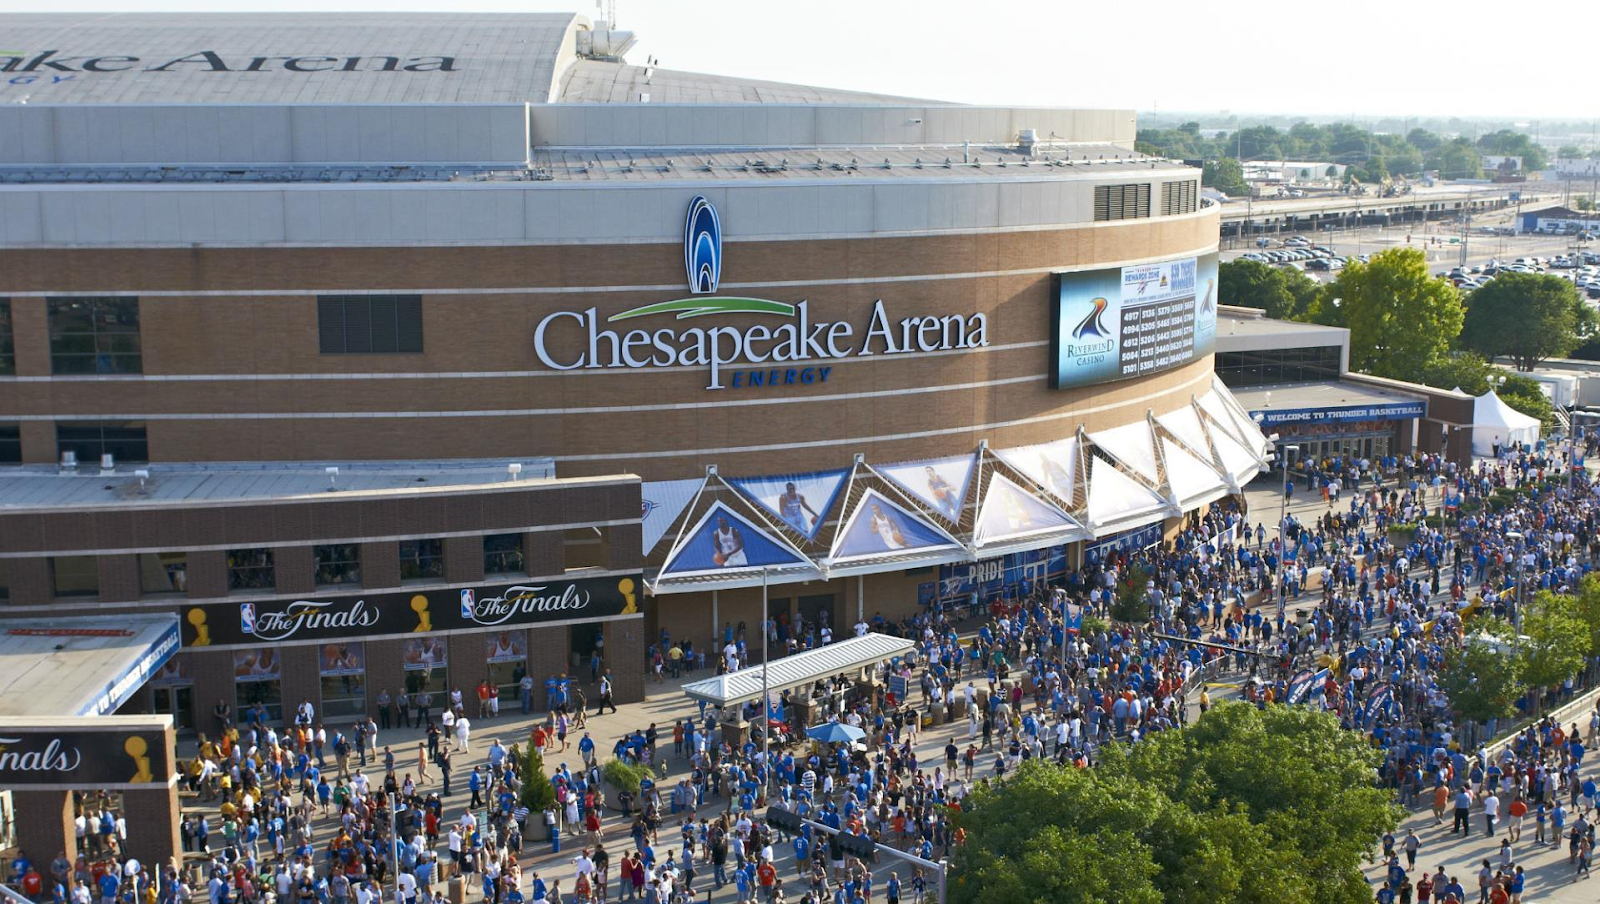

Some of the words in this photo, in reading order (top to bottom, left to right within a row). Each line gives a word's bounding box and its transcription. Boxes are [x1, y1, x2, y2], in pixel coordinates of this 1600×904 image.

[145, 50, 462, 73] Arena
[533, 300, 853, 390] Chesapeake
[858, 299, 989, 356] Arena
[1067, 340, 1114, 358] RIVERWIND
[1077, 356, 1104, 366] CASINO
[732, 367, 832, 388] ENERGY
[1267, 413, 1310, 422] WELCOME
[1313, 412, 1324, 420] TO
[1328, 409, 1367, 419] THUNDER
[1369, 406, 1423, 416] BASKETBALL
[969, 564, 1004, 585] PRIDE
[475, 597, 509, 617] The
[504, 585, 590, 623] Finals
[256, 611, 292, 632] The
[287, 600, 379, 638] Finals
